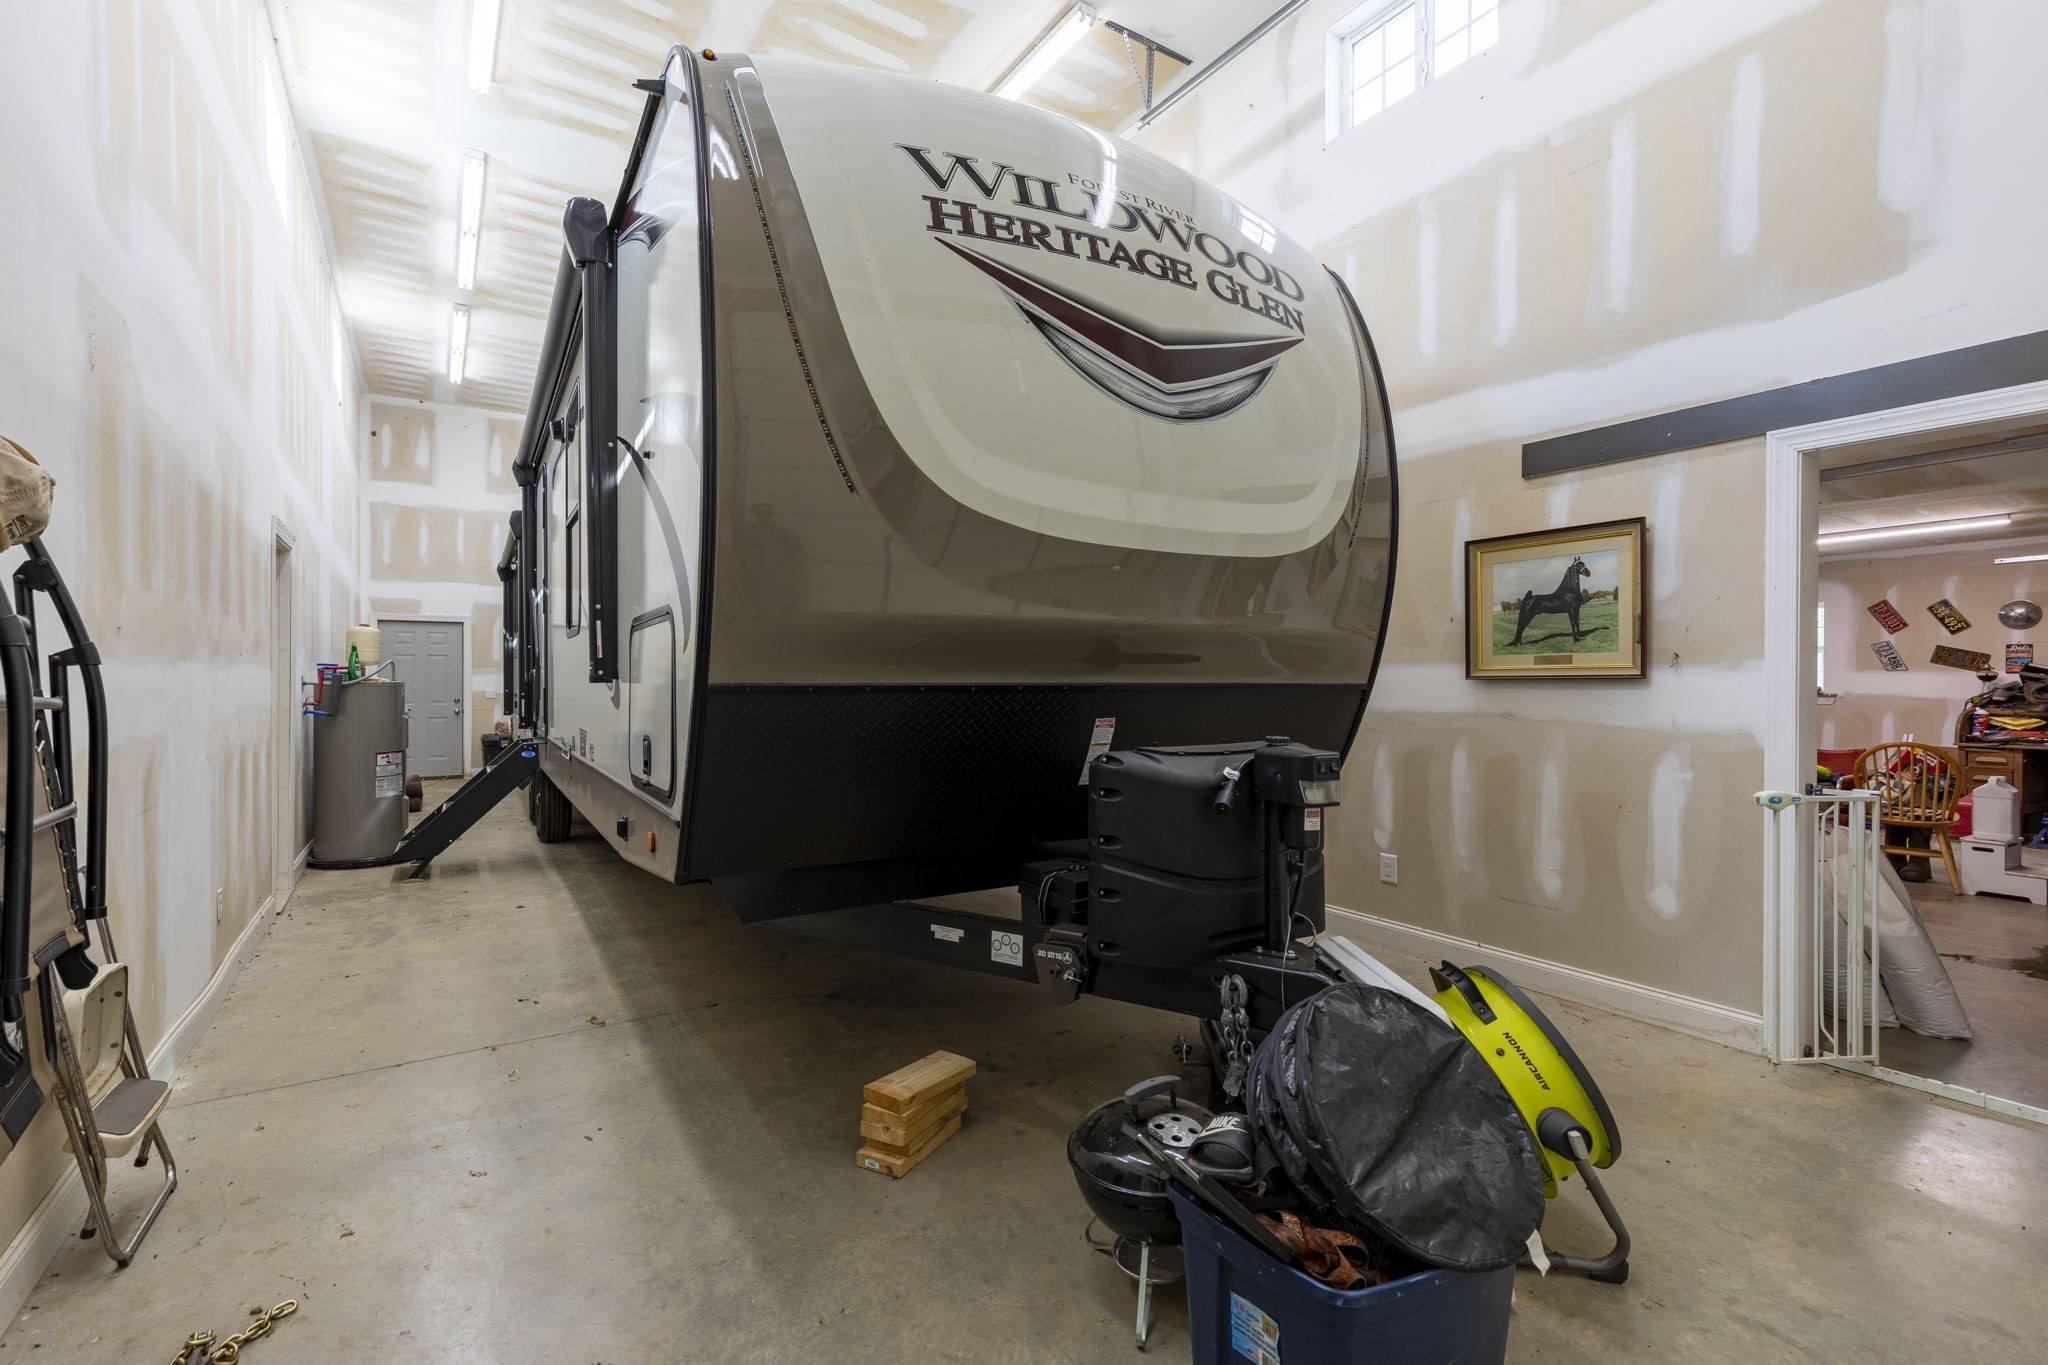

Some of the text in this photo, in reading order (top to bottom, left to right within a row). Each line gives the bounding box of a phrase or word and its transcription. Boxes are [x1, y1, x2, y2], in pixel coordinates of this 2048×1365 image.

[893, 142, 1306, 303] WILDWOOD
[1066, 172, 1196, 225] FOST RIVER
[921, 194, 1306, 336] HERITAGE GLEN
[1046, 951, 1063, 960] BLUE
[1502, 1031, 1551, 1091] AIRCANNON
[1209, 1115, 1241, 1129] NIKE
